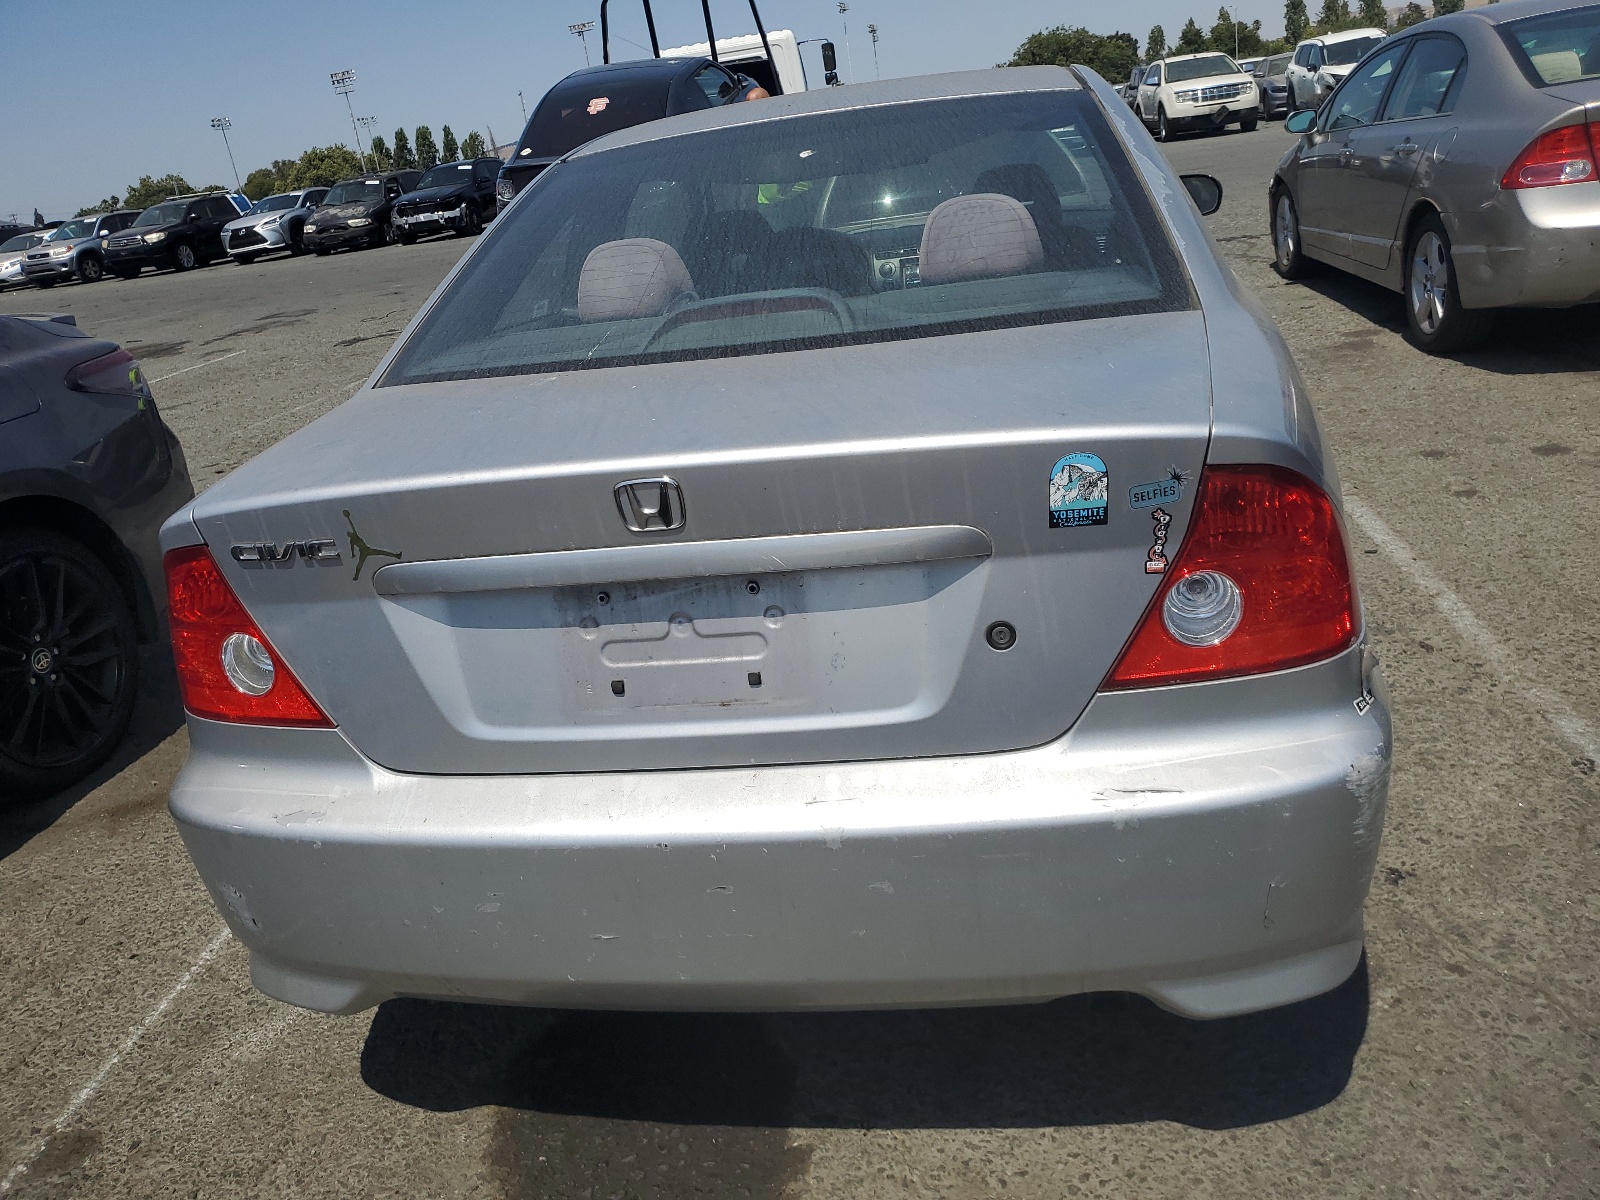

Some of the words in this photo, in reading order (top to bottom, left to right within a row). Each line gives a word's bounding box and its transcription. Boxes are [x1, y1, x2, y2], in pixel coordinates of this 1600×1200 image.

[1133, 485, 1176, 503] SELFIES
[1052, 507, 1105, 519] YOSEMITE
[1059, 519, 1093, 528] California
[231, 539, 341, 563] CIVIC
